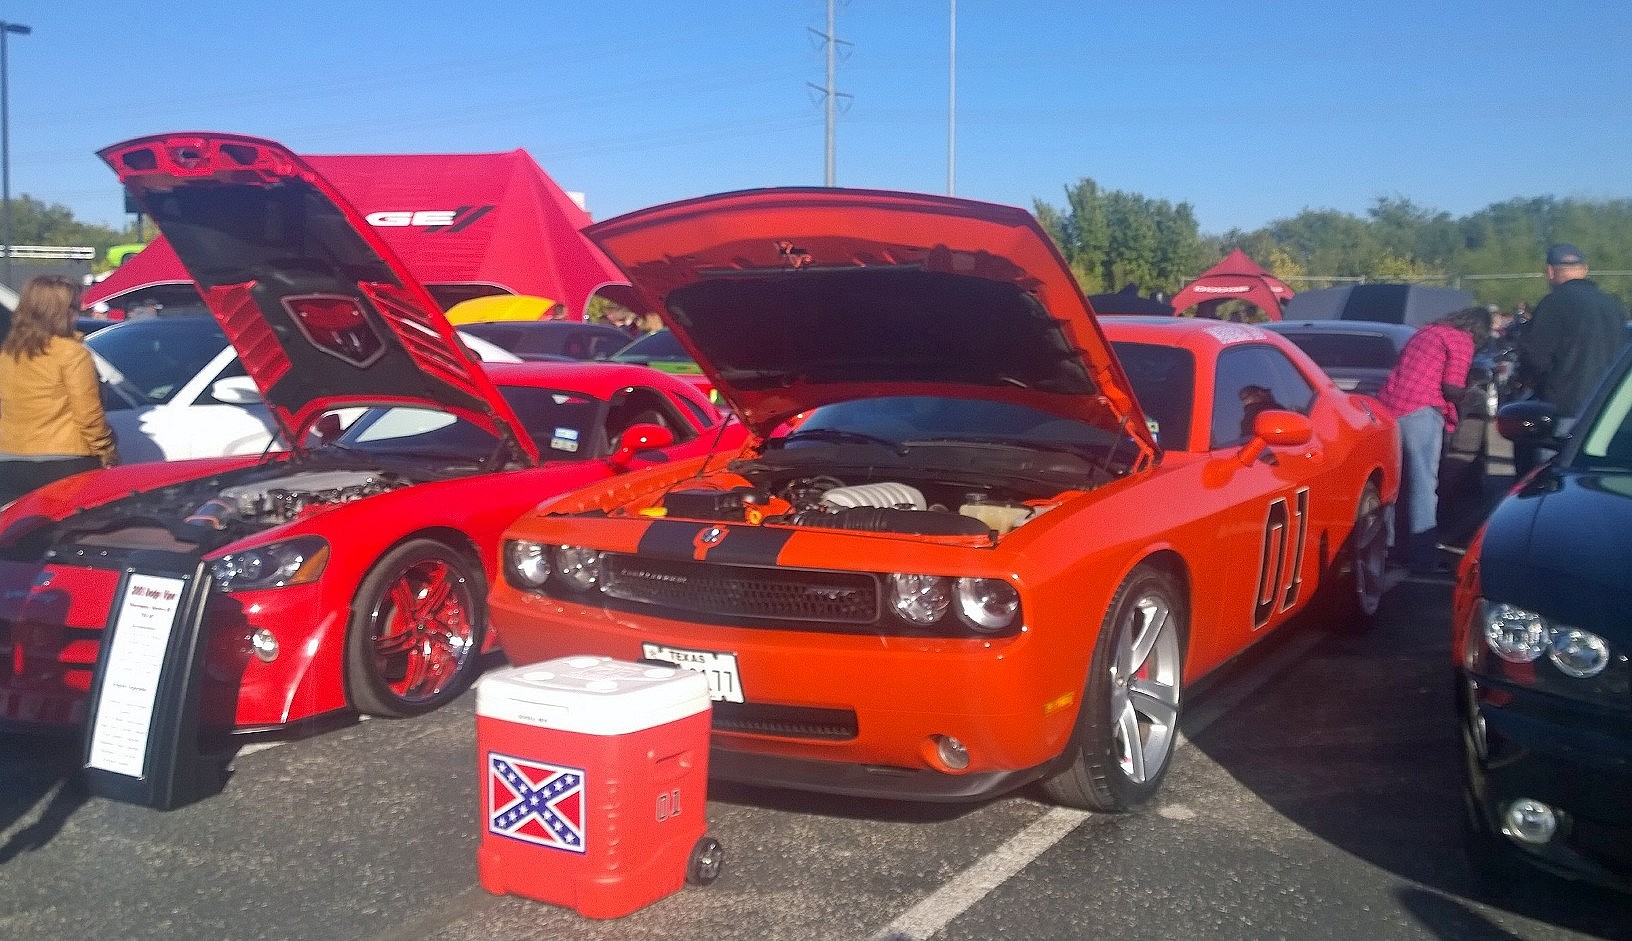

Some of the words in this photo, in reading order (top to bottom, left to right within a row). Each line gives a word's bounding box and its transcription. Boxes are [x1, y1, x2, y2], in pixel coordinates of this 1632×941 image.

[1252, 486, 1310, 632] 01
[669, 651, 706, 664] TEXAS
[655, 788, 681, 823] 01
